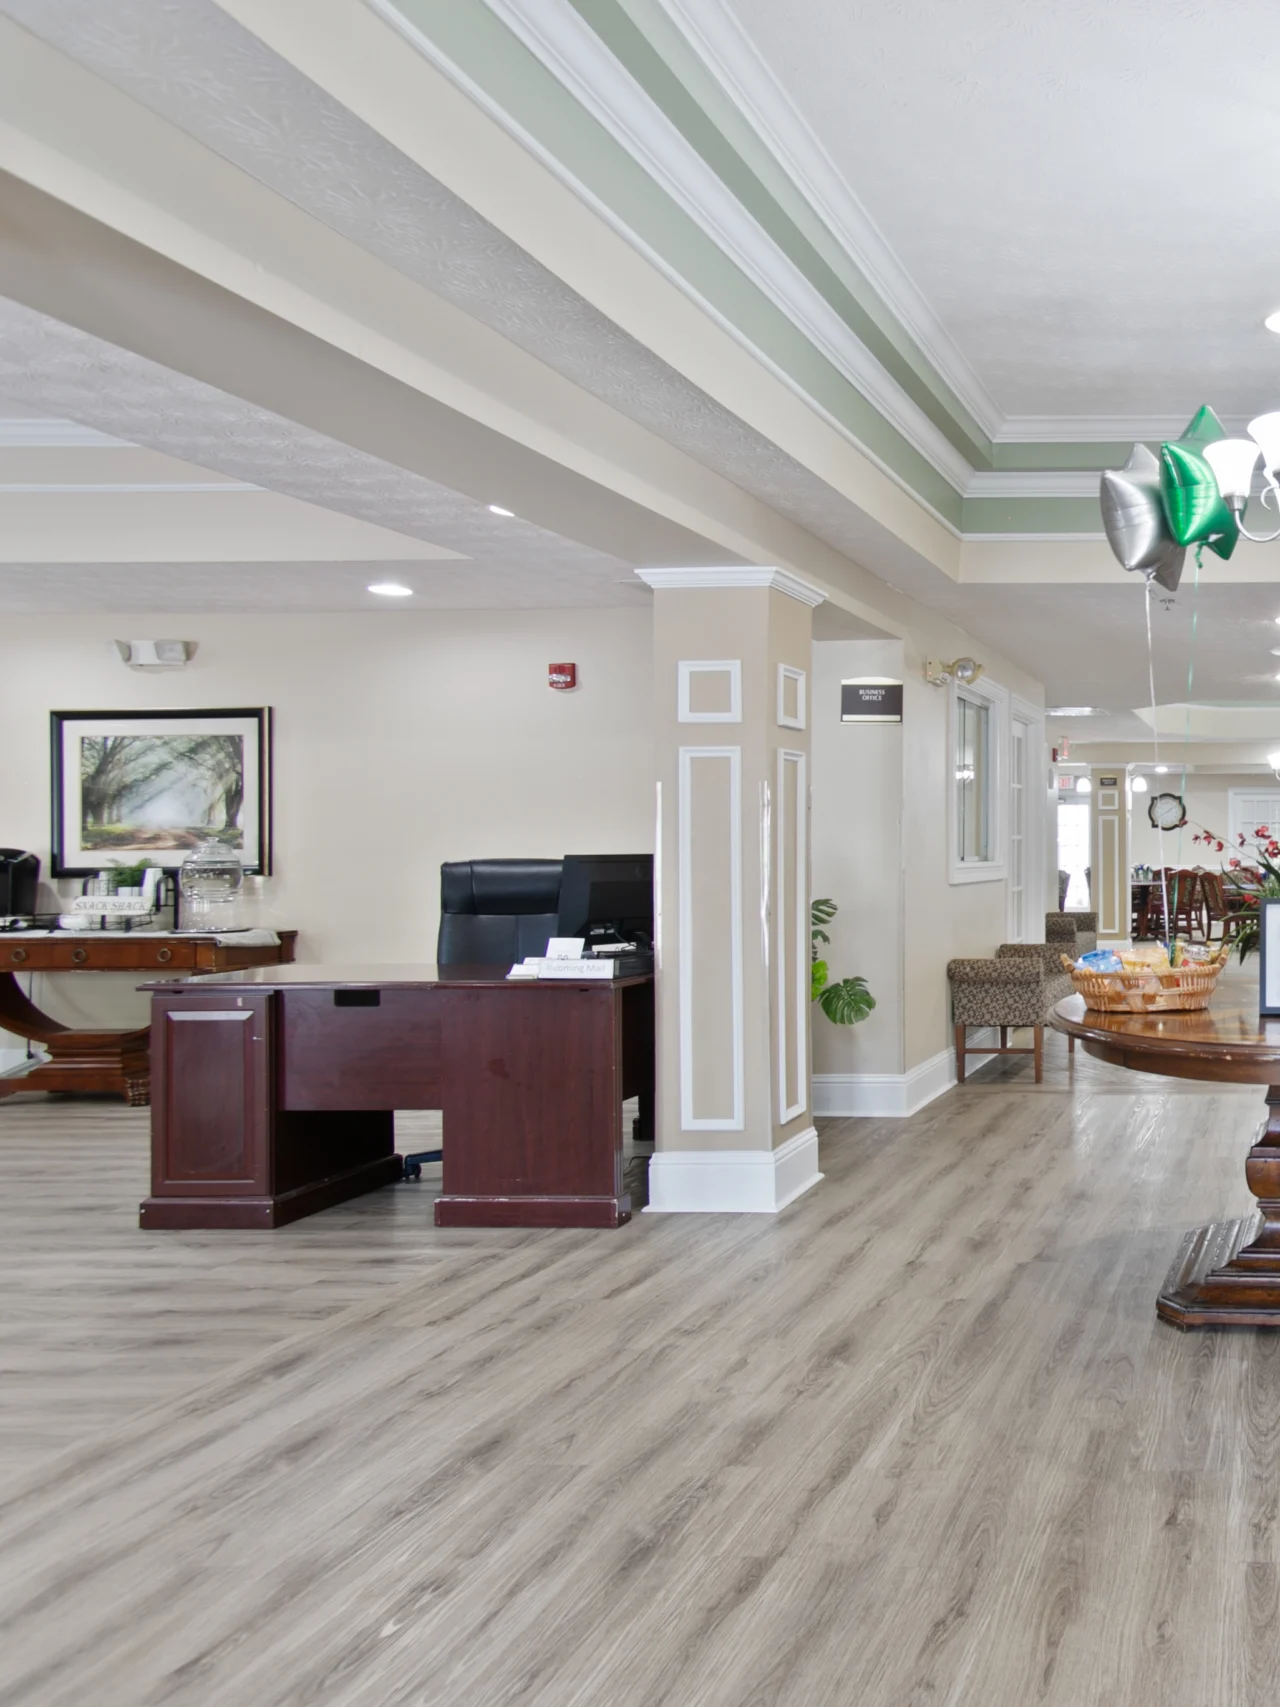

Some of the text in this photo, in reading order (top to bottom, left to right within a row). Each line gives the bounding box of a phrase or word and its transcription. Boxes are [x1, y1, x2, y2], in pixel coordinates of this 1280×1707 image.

[111, 901, 146, 911] SHACK
[546, 963, 606, 974] Incoming Mail
